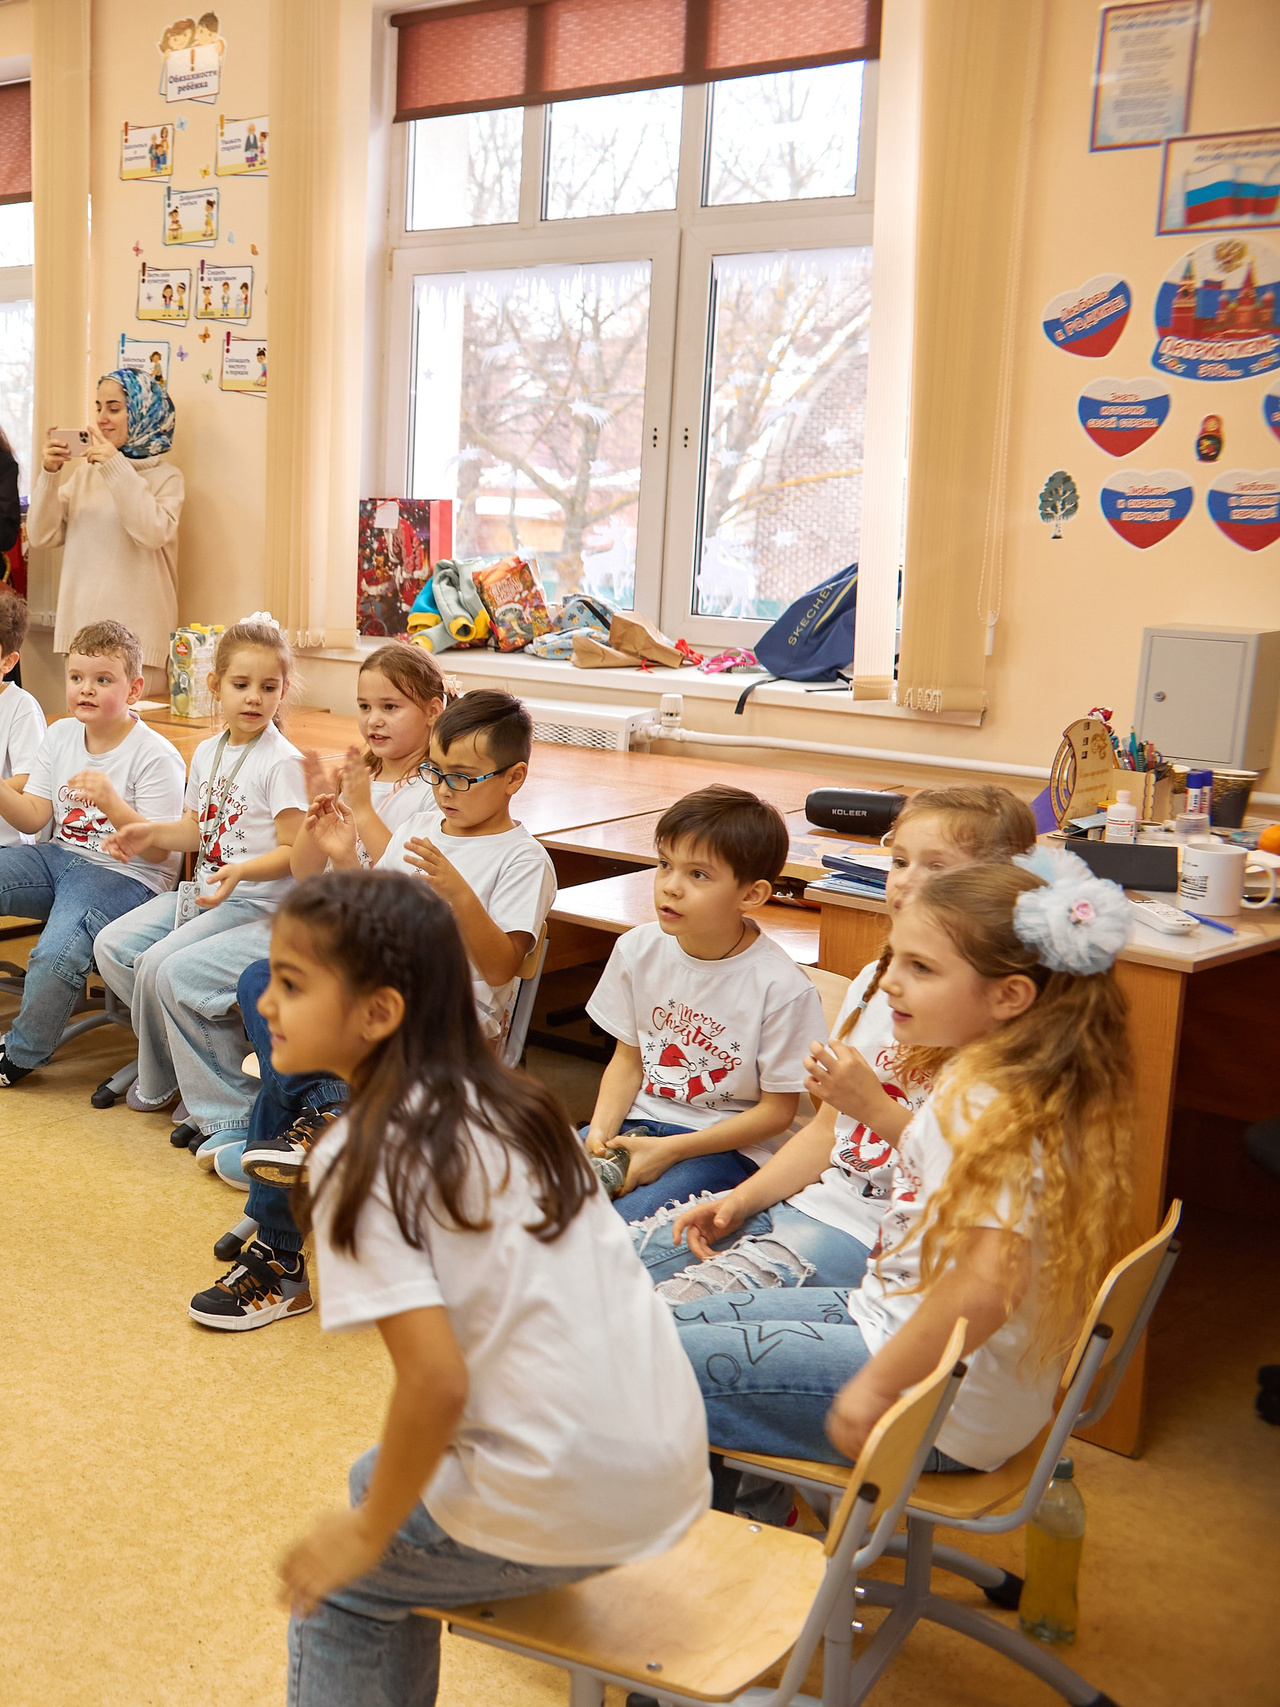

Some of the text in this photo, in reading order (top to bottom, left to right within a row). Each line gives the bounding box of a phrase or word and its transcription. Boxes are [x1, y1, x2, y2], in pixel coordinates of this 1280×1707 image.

[1060, 290, 1110, 322] Любовь
[831, 808, 868, 817] KOLEER
[677, 1003, 726, 1038] Merry
[652, 1006, 743, 1071] Christmas
